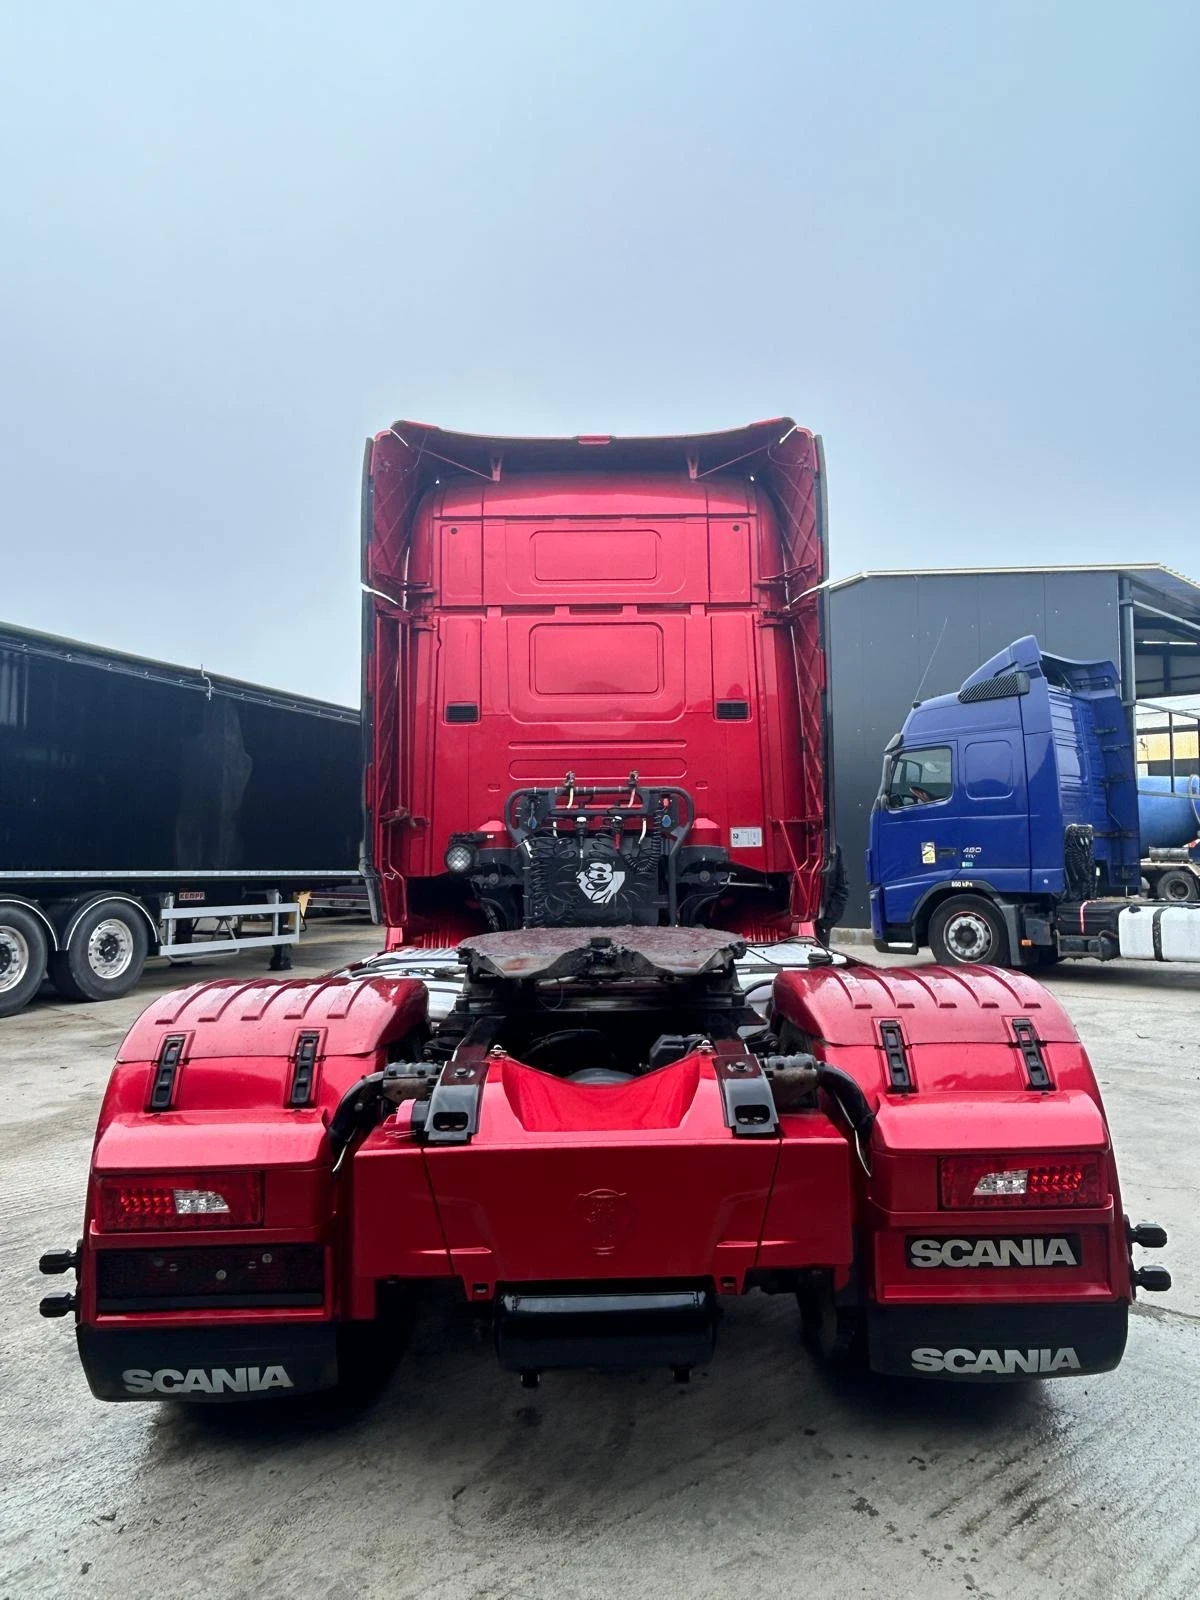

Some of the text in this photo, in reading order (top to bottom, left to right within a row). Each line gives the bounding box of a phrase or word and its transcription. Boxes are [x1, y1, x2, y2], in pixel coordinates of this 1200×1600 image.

[910, 1238, 1077, 1268] SCANIA
[911, 1347, 1081, 1374] SCANIA
[122, 1365, 294, 1393] SCANIA
